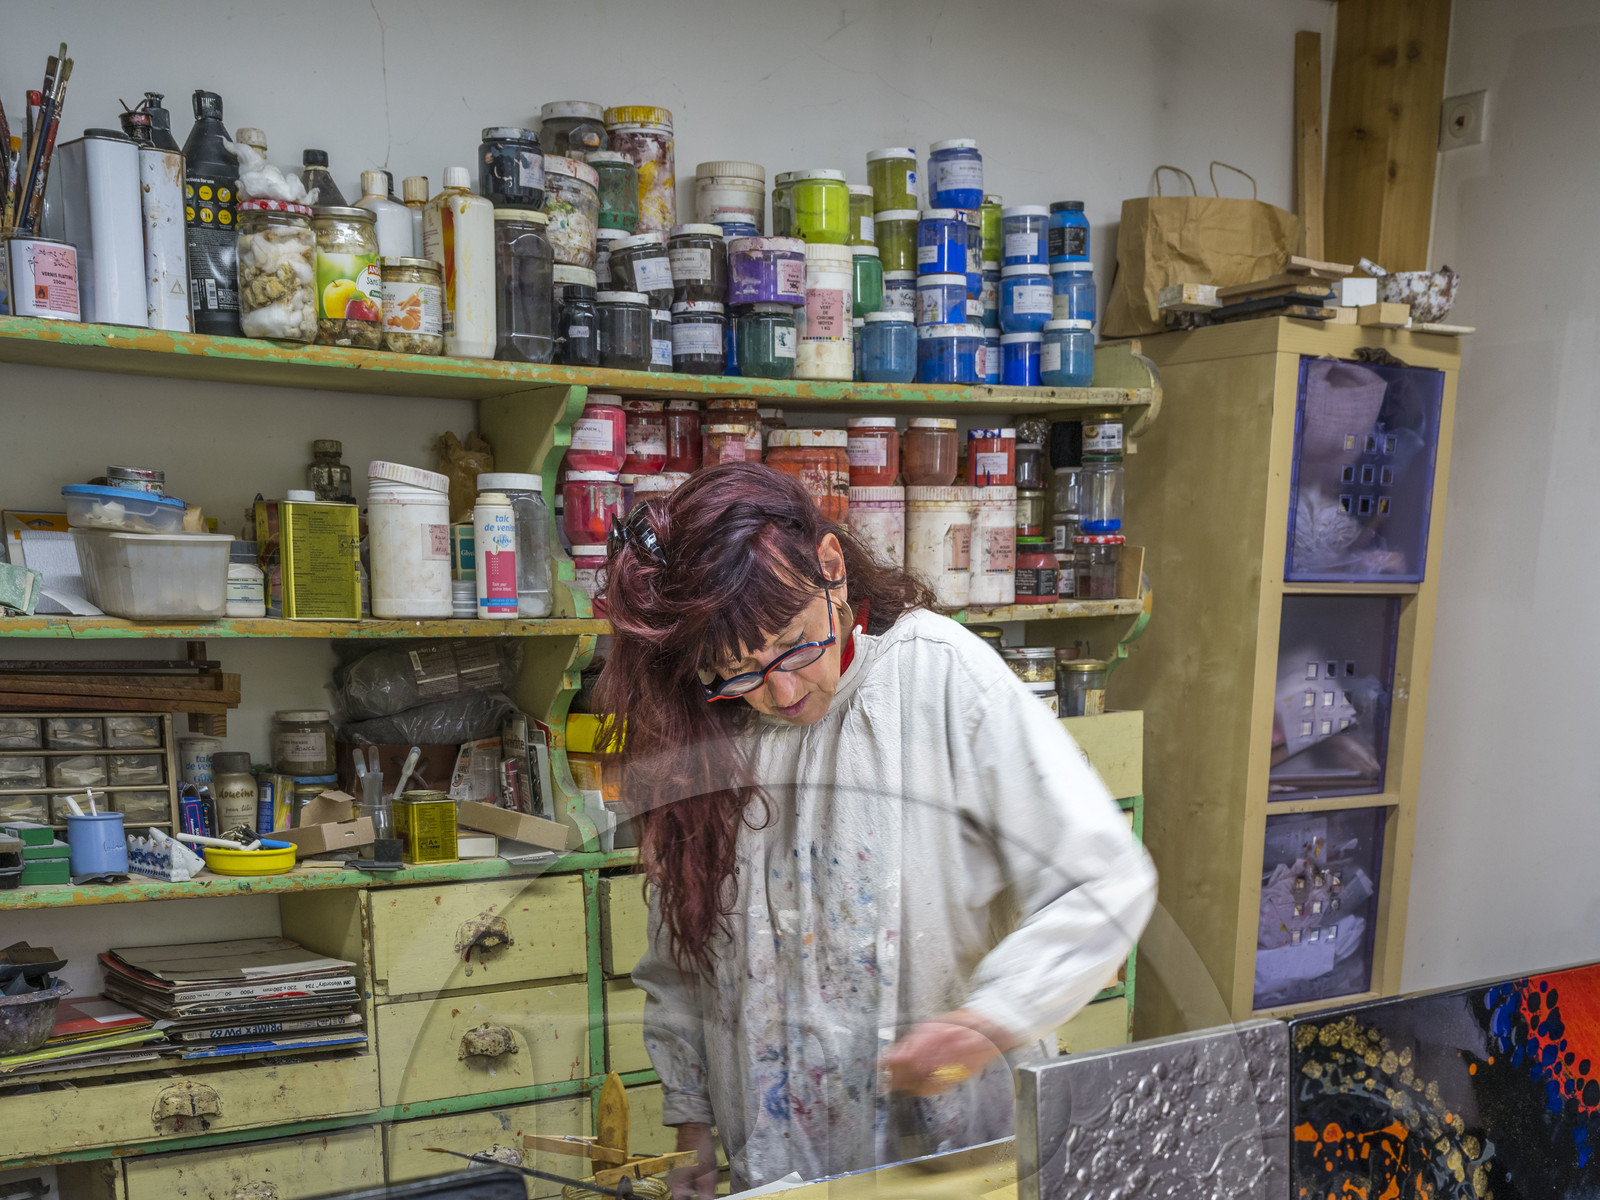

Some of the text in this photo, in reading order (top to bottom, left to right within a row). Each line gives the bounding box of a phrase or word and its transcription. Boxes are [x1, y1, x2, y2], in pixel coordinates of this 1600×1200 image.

[495, 515, 509, 523] talc
[484, 523, 494, 531] de
[246, 1023, 283, 1032] PRIMEX
[210, 1030, 222, 1038] 62
